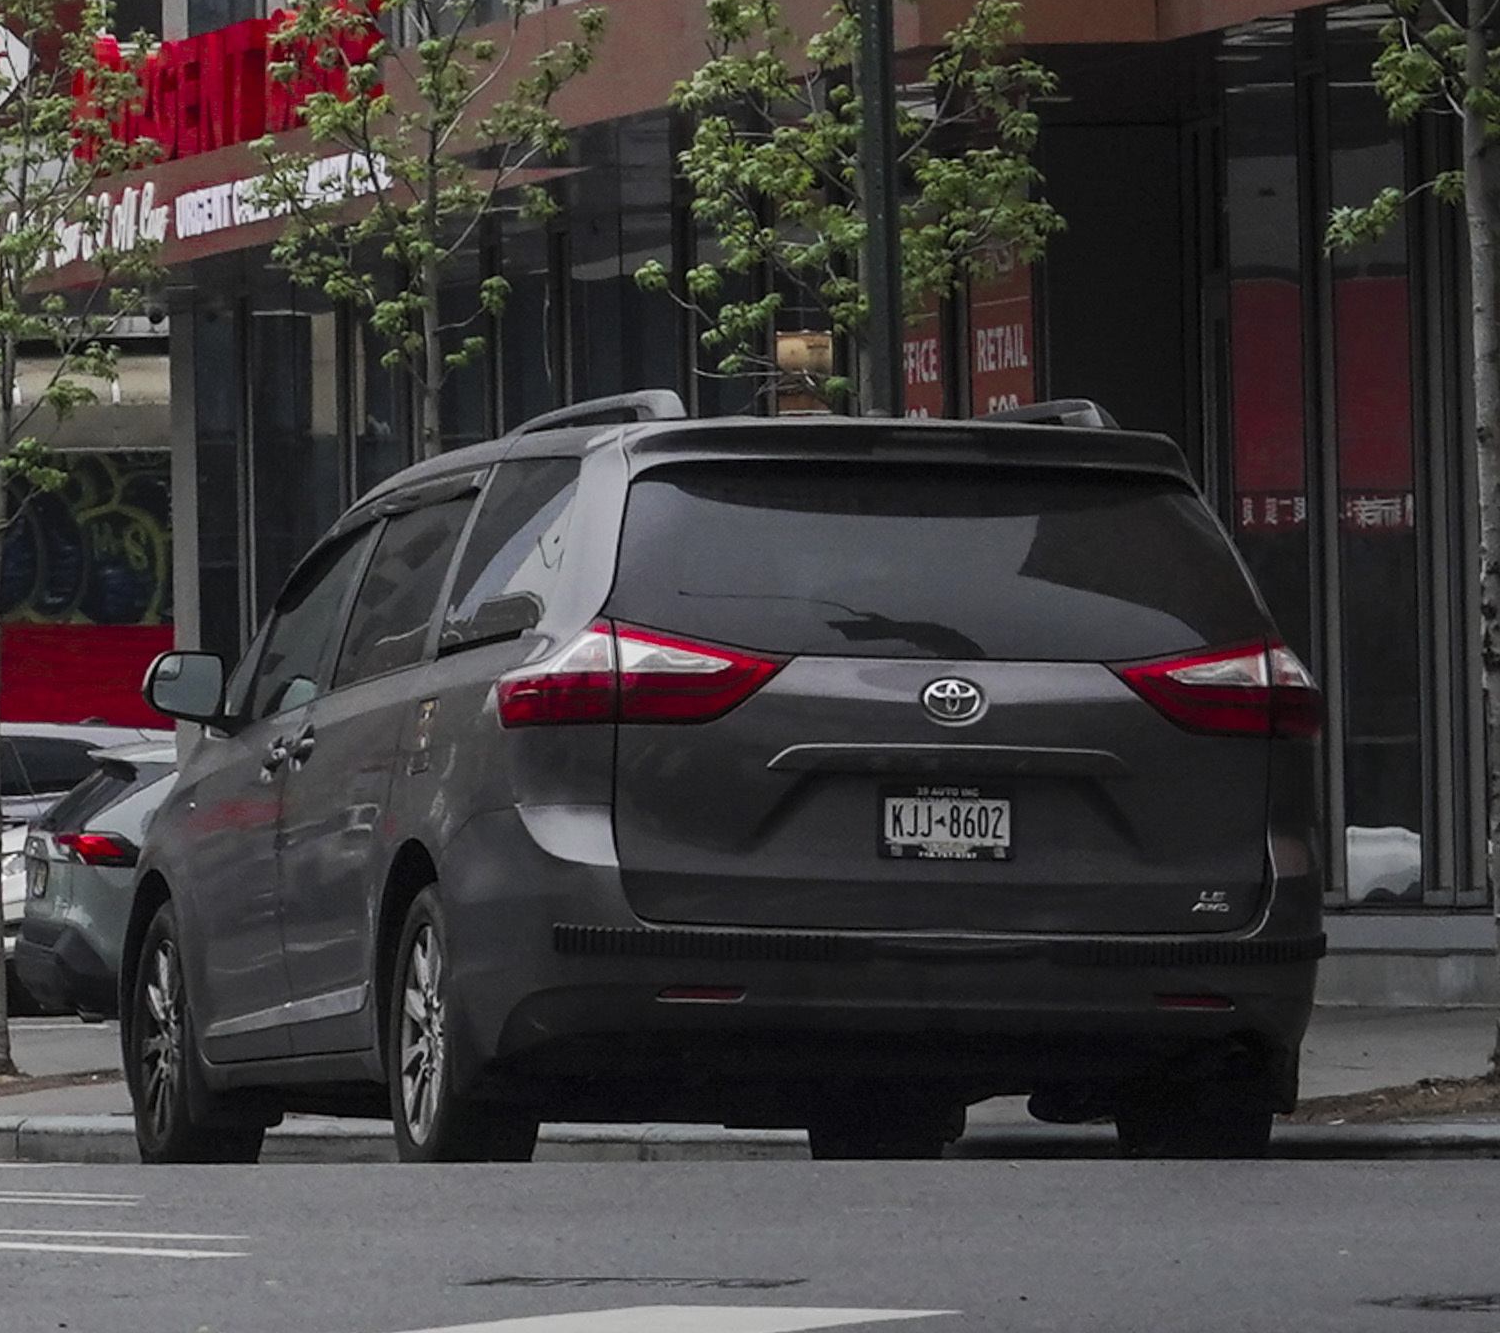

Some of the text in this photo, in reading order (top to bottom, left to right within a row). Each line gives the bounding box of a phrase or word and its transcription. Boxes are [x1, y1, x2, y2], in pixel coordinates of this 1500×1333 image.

[976, 323, 1029, 373] RETAIL
[891, 803, 1005, 839] KJJ 8602
